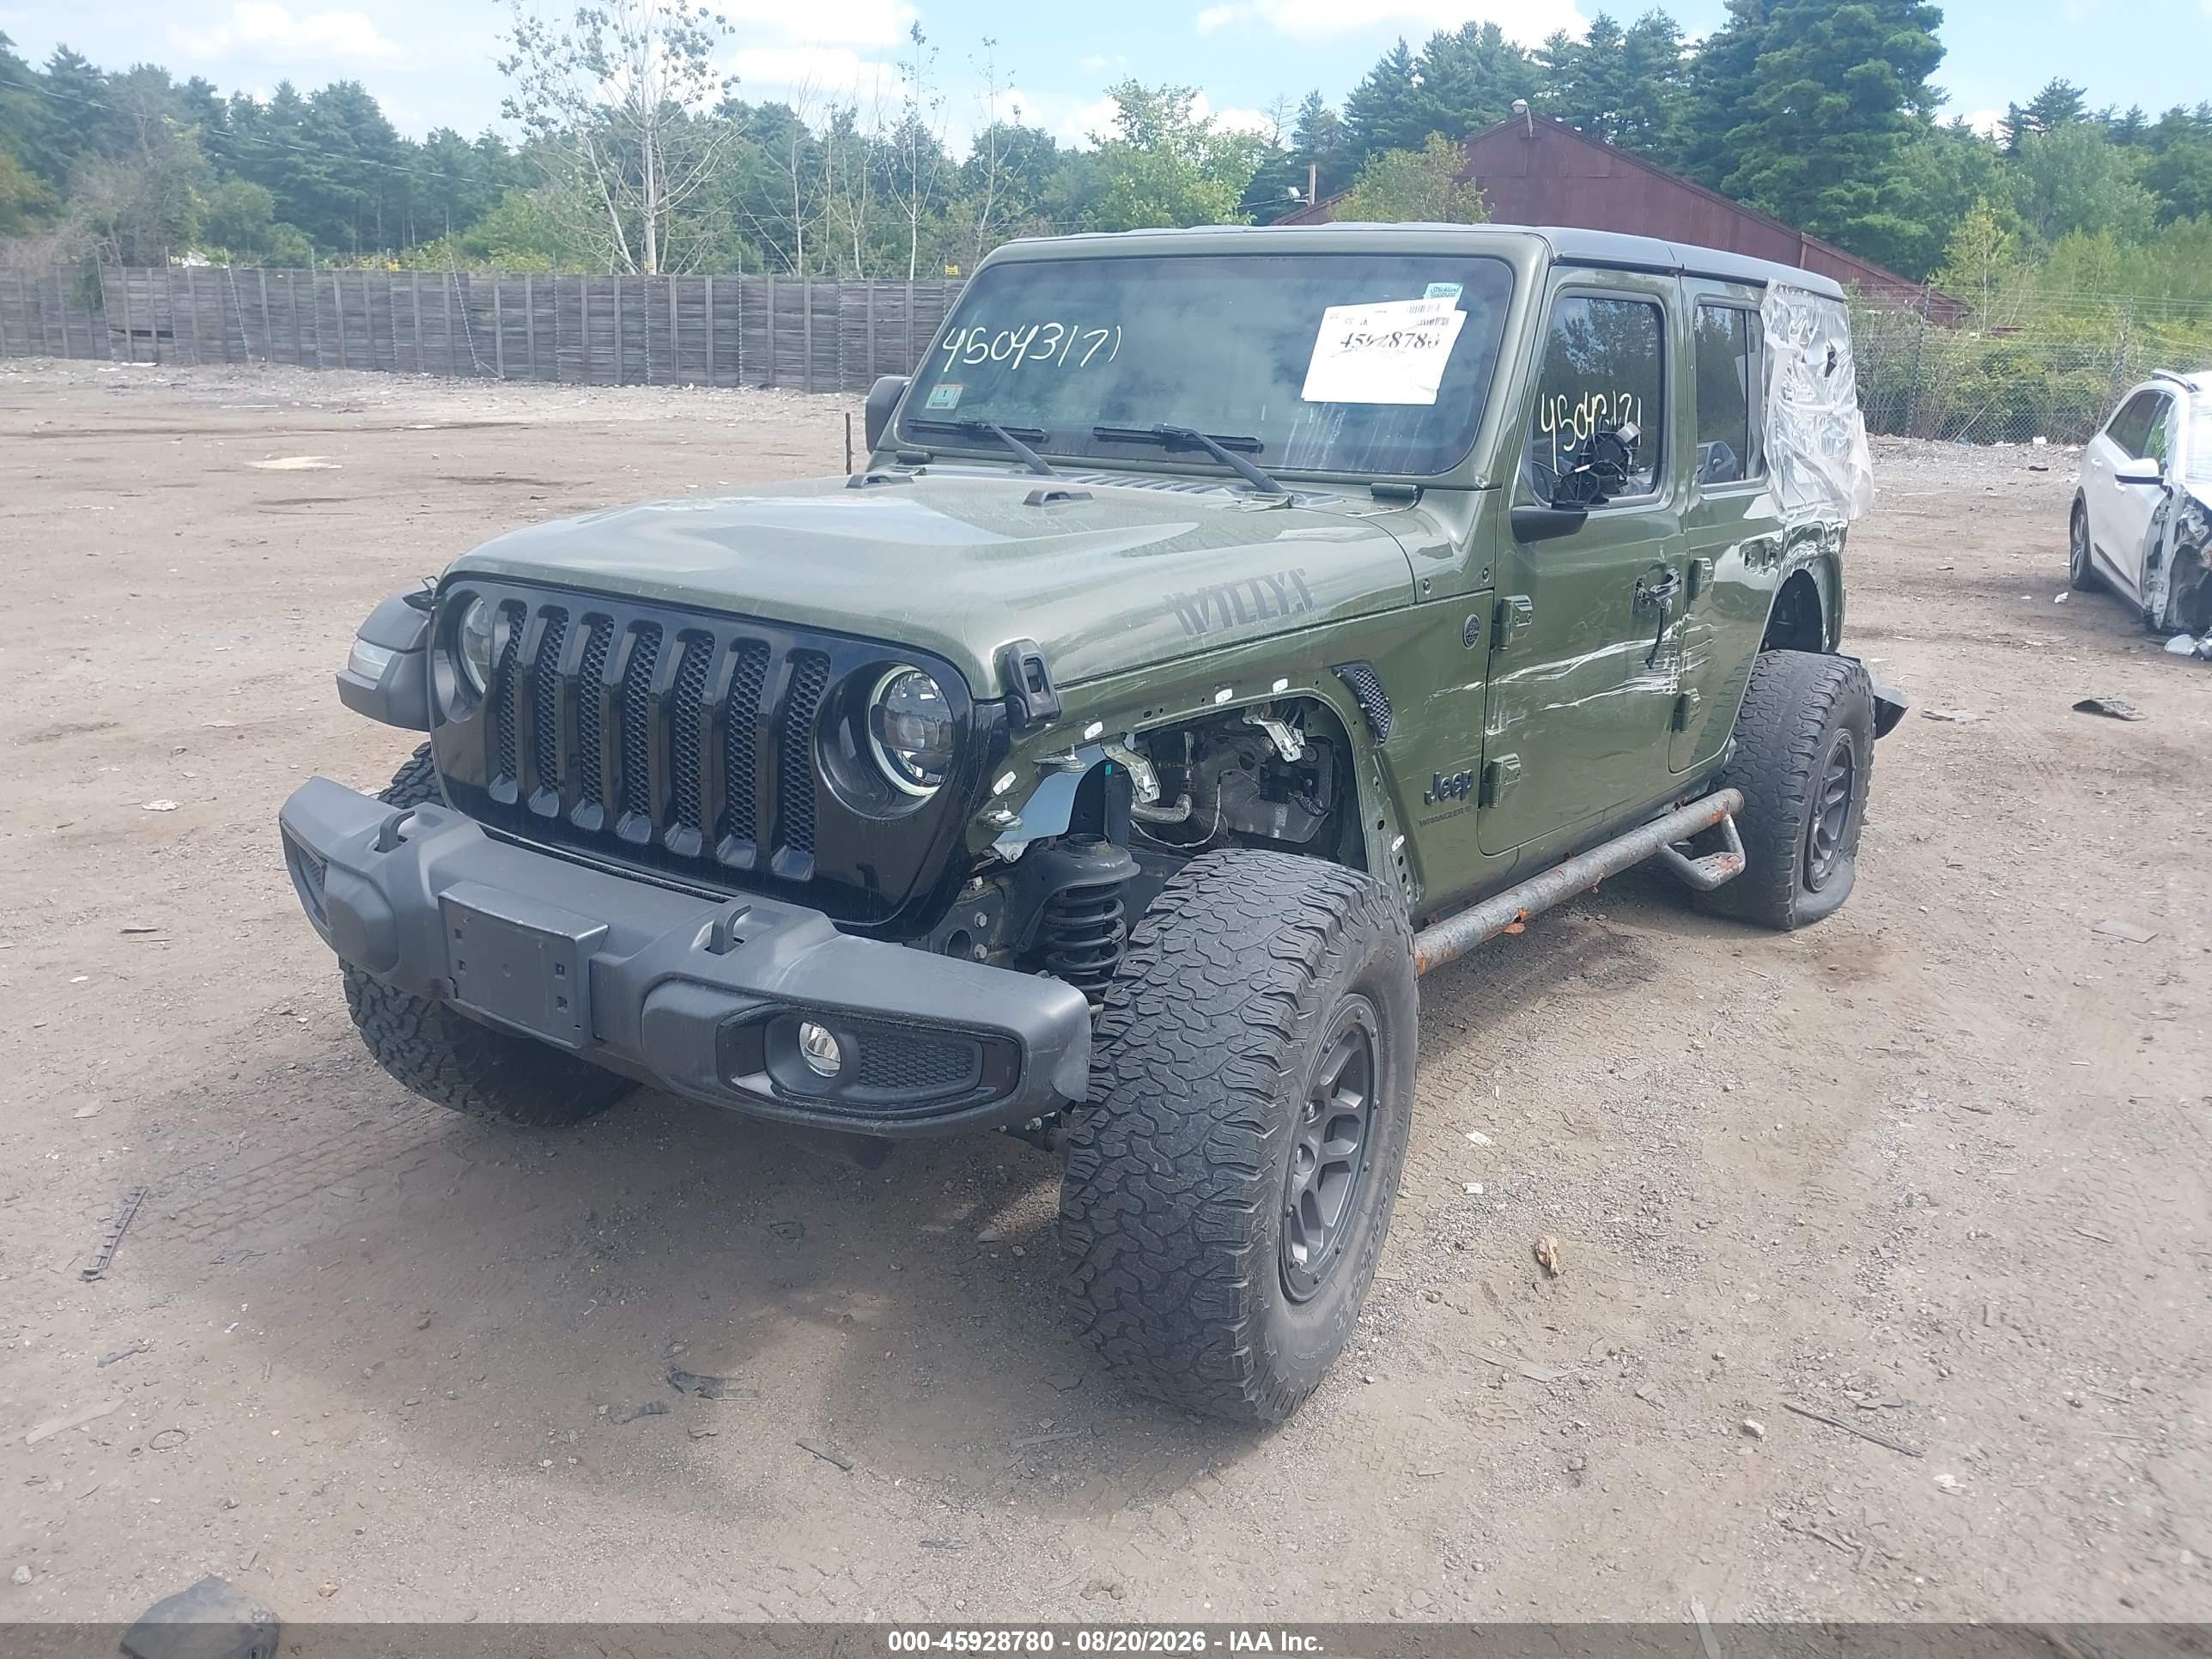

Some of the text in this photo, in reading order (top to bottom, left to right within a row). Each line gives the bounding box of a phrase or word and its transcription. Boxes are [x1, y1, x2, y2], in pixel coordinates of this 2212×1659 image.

[942, 322, 1121, 373] 45043171
[1163, 567, 1313, 636] WILLYS
[1424, 769, 1473, 806] Jeep
